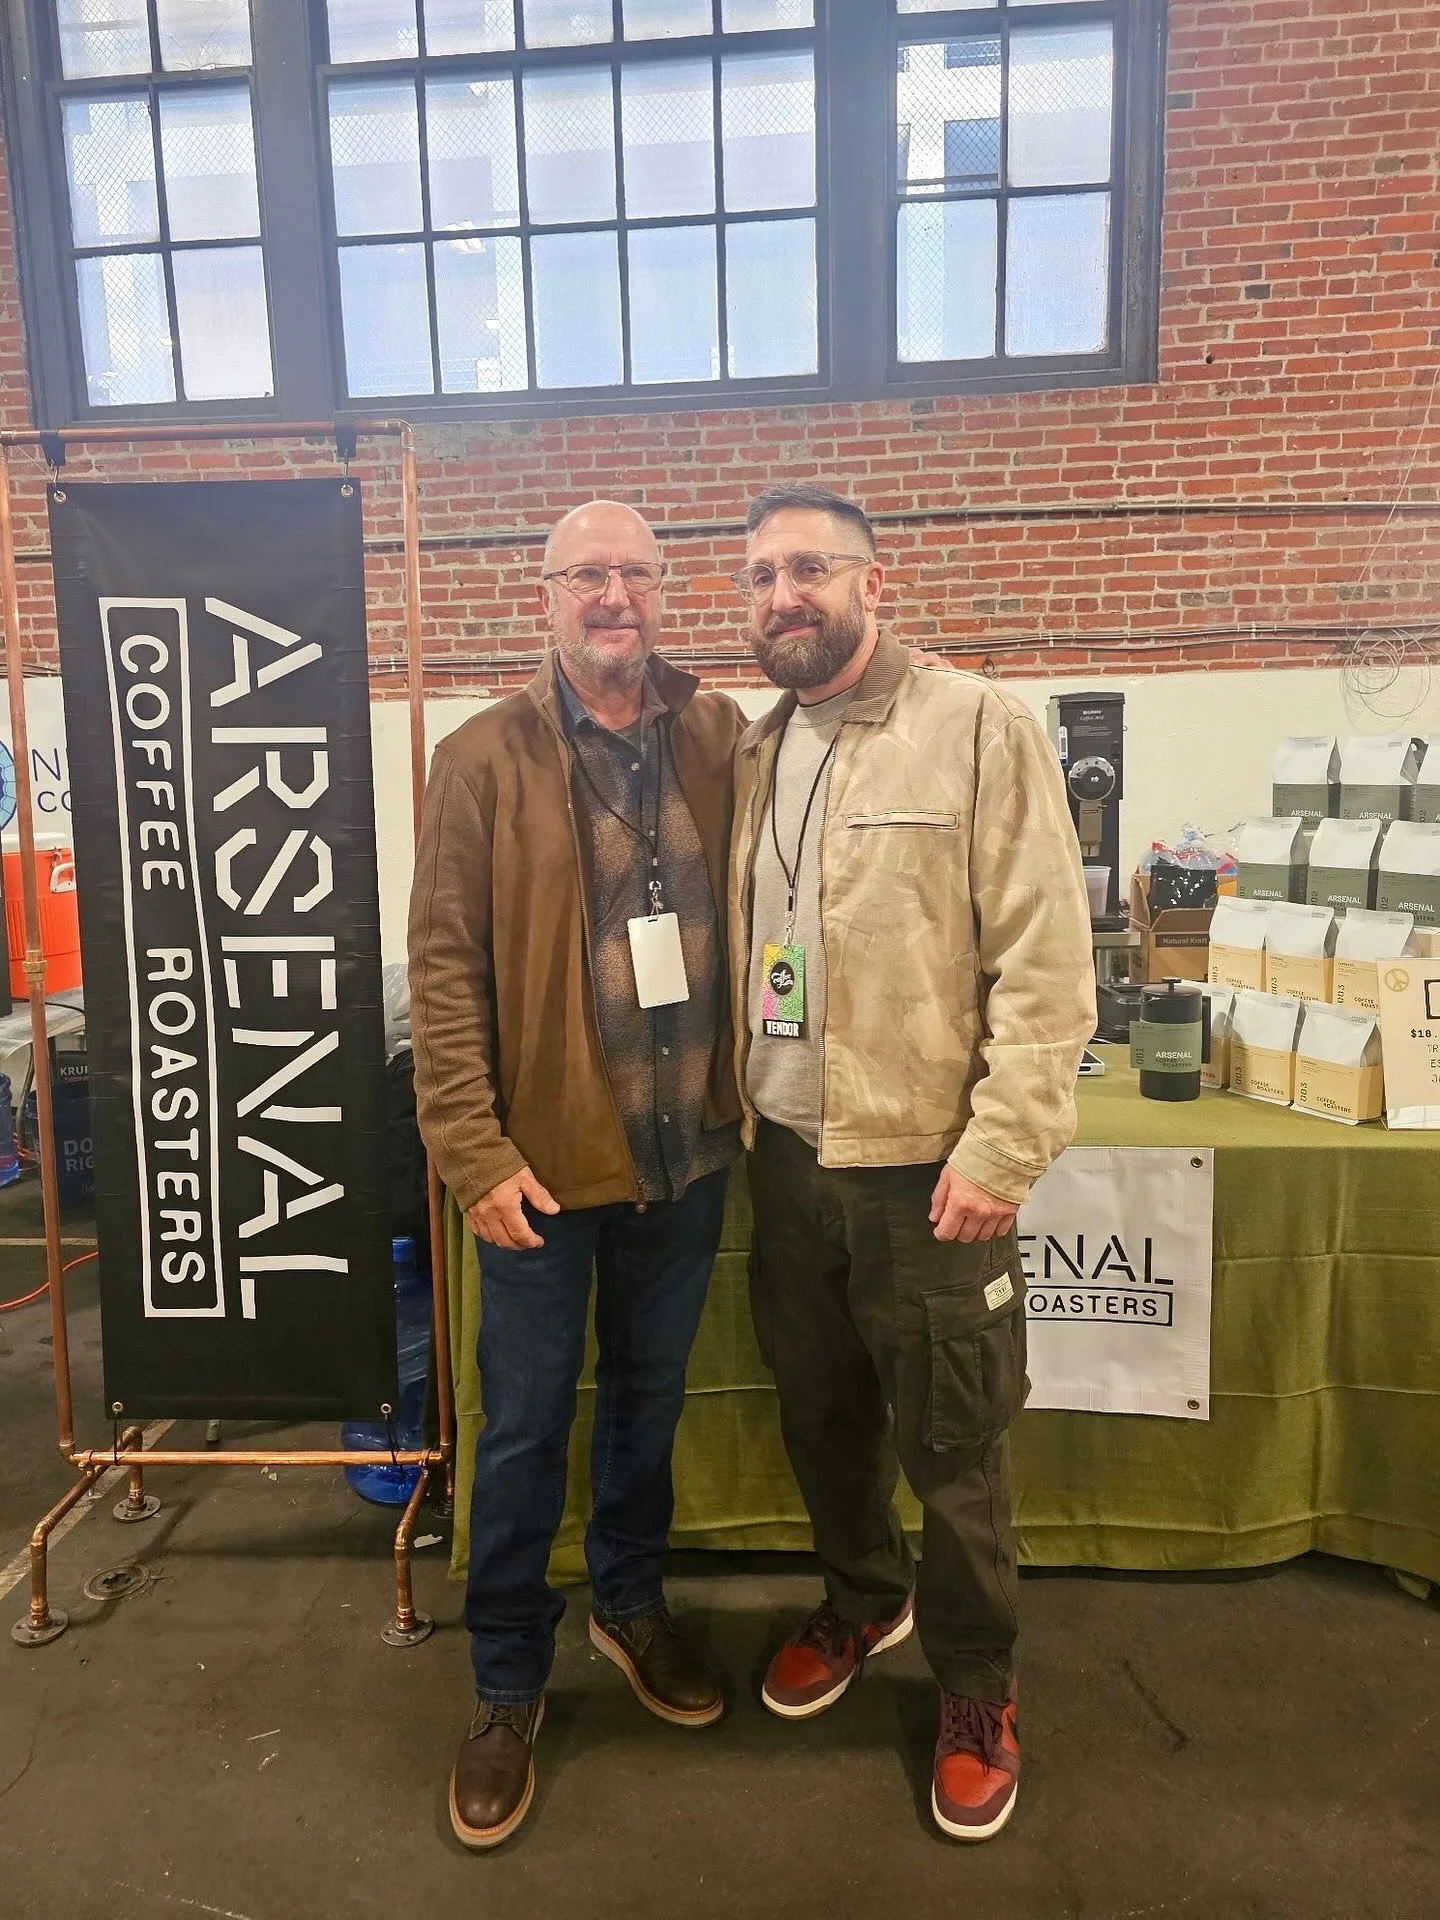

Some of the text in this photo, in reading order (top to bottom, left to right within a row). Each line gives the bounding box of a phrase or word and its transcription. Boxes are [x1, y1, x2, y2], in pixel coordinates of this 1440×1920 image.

[1291, 810, 1324, 818] ARSENAL
[1359, 812, 1393, 820] ARSENAL
[1252, 889, 1284, 898] ARSENAL
[1327, 895, 1362, 904] ARSENAL
[1398, 902, 1435, 912] ARSENAL
[1162, 936, 1209, 945] Natural Kraft
[119, 634, 206, 1284] COFFEE ROASTERS
[205, 597, 348, 1319] ARSENAL
[766, 1021, 799, 1037] VENDOR
[1155, 1051, 1192, 1059] ARSENAL
[1300, 1082, 1308, 1102] 003
[1316, 1096, 1336, 1104] COFFEE
[1323, 1103, 1352, 1113] ROASTERS
[1029, 1294, 1158, 1317] OASTERS
